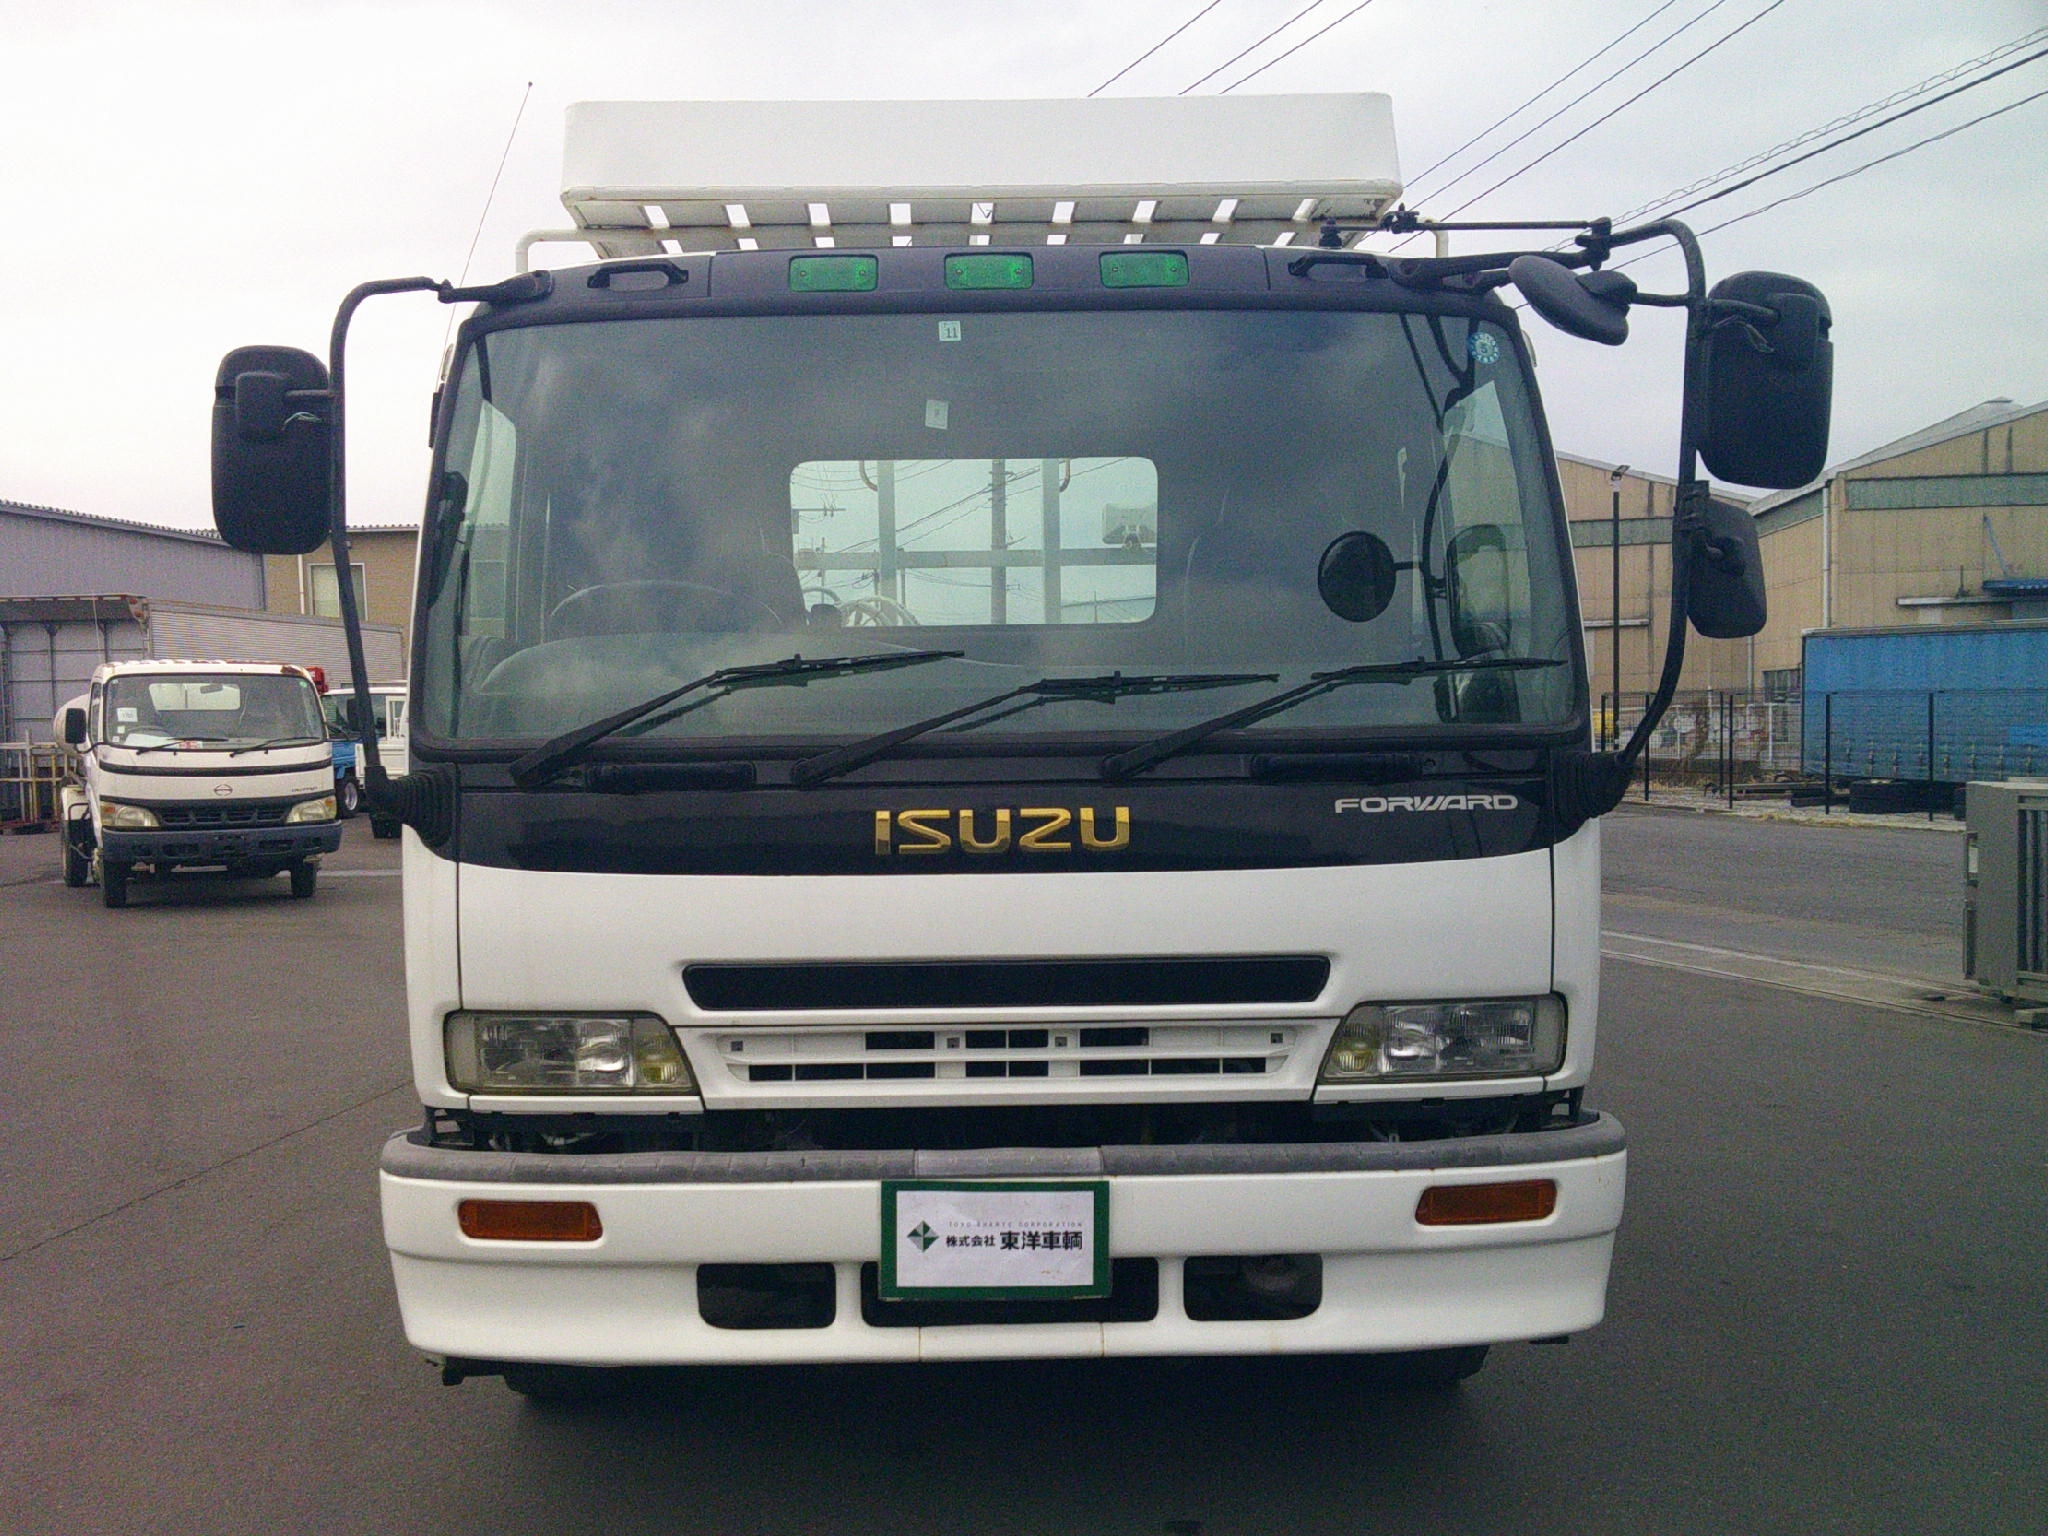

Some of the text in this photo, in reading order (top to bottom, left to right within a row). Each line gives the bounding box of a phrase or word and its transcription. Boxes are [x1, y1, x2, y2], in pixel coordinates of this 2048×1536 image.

[1334, 794, 1519, 814] FORWARD
[875, 806, 1130, 855] ISUZU
[946, 1235, 996, 1248] 株式会社
